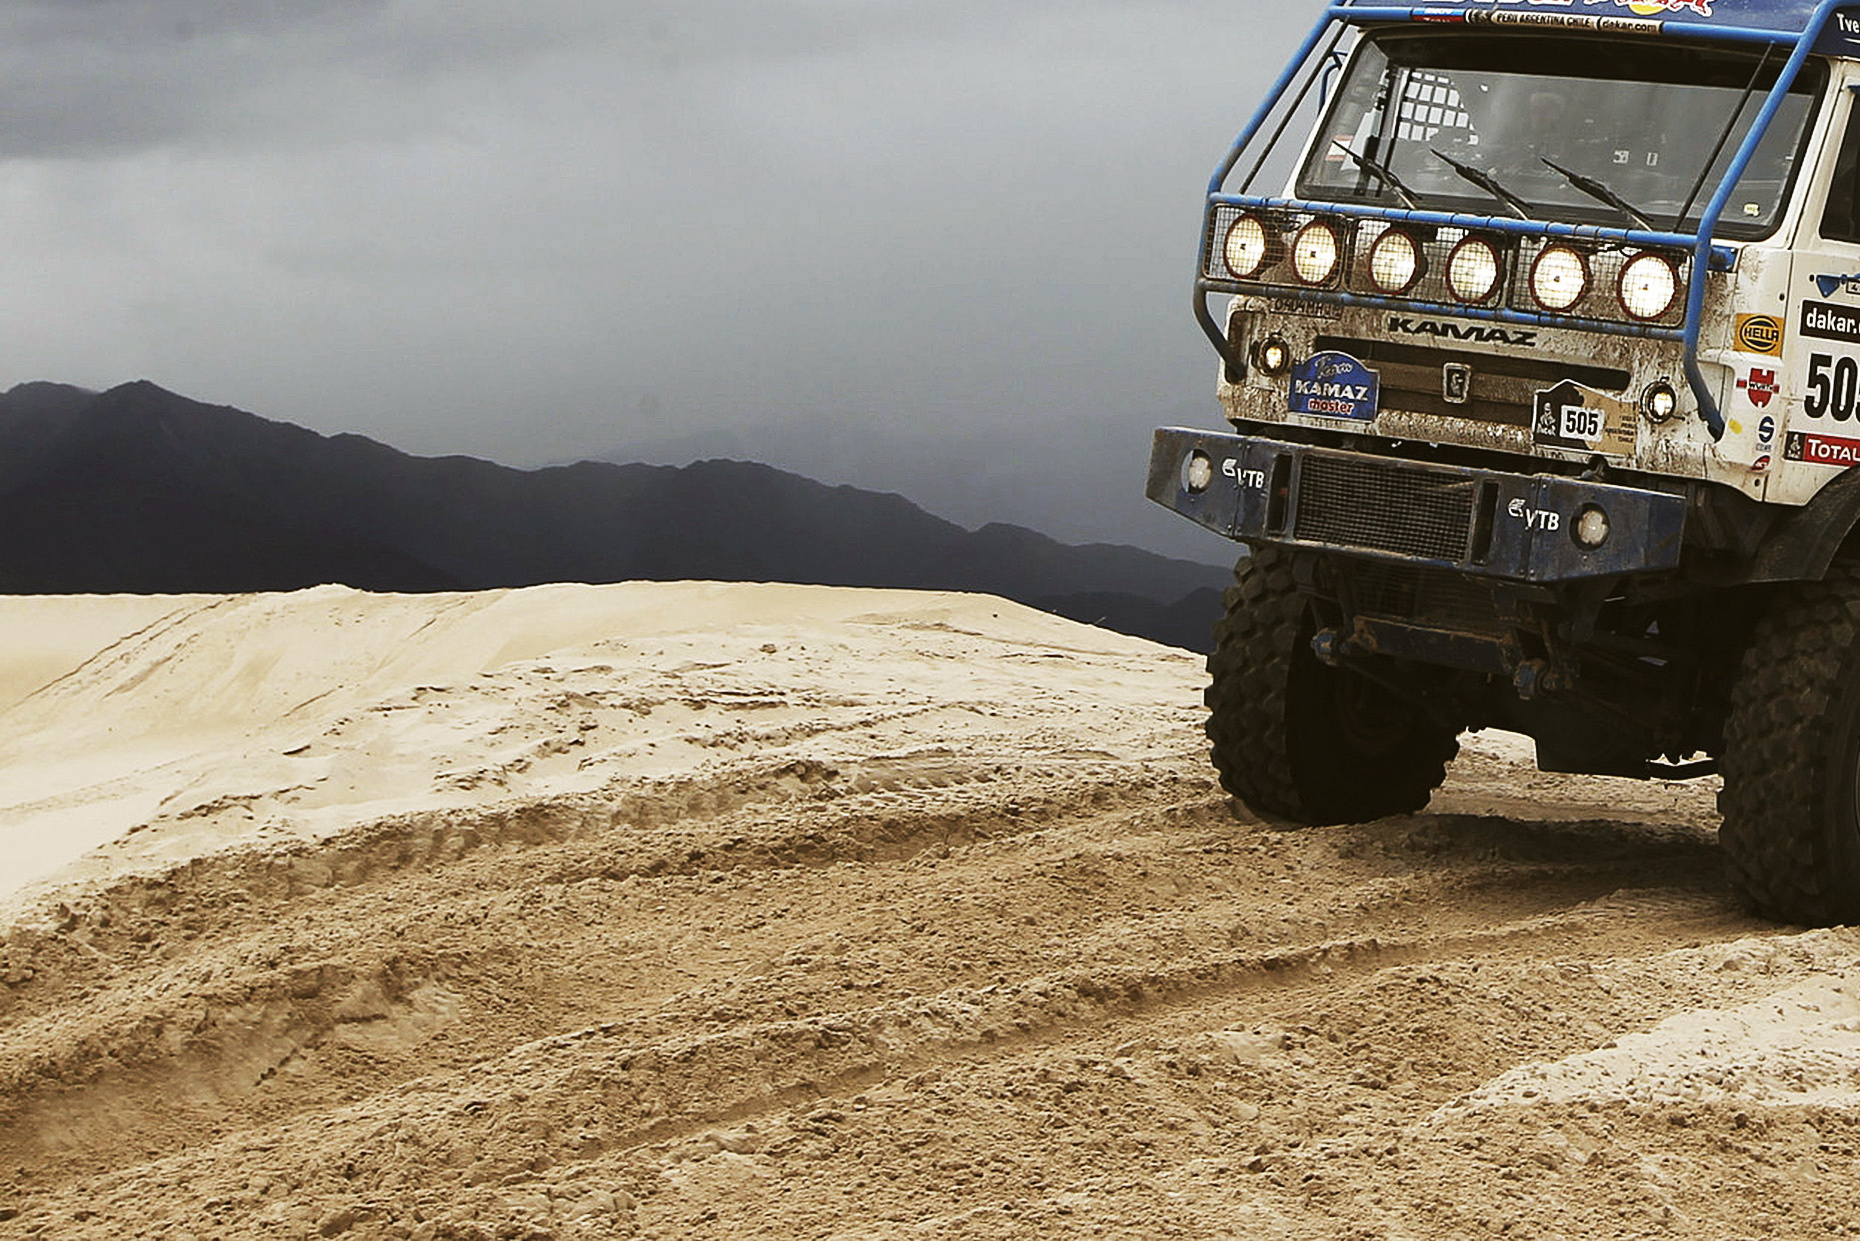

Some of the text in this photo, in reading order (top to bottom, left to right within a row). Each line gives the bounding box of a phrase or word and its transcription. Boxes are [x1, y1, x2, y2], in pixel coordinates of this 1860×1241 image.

[1388, 317, 1538, 347] KAMAZ
[1744, 326, 1779, 343] HELLA
[1295, 380, 1369, 401] KAMAZ
[1566, 410, 1599, 436] 505
[1808, 439, 1860, 461] TOTAL
[1237, 468, 1264, 488] VTB
[1525, 508, 1560, 530] VTB
